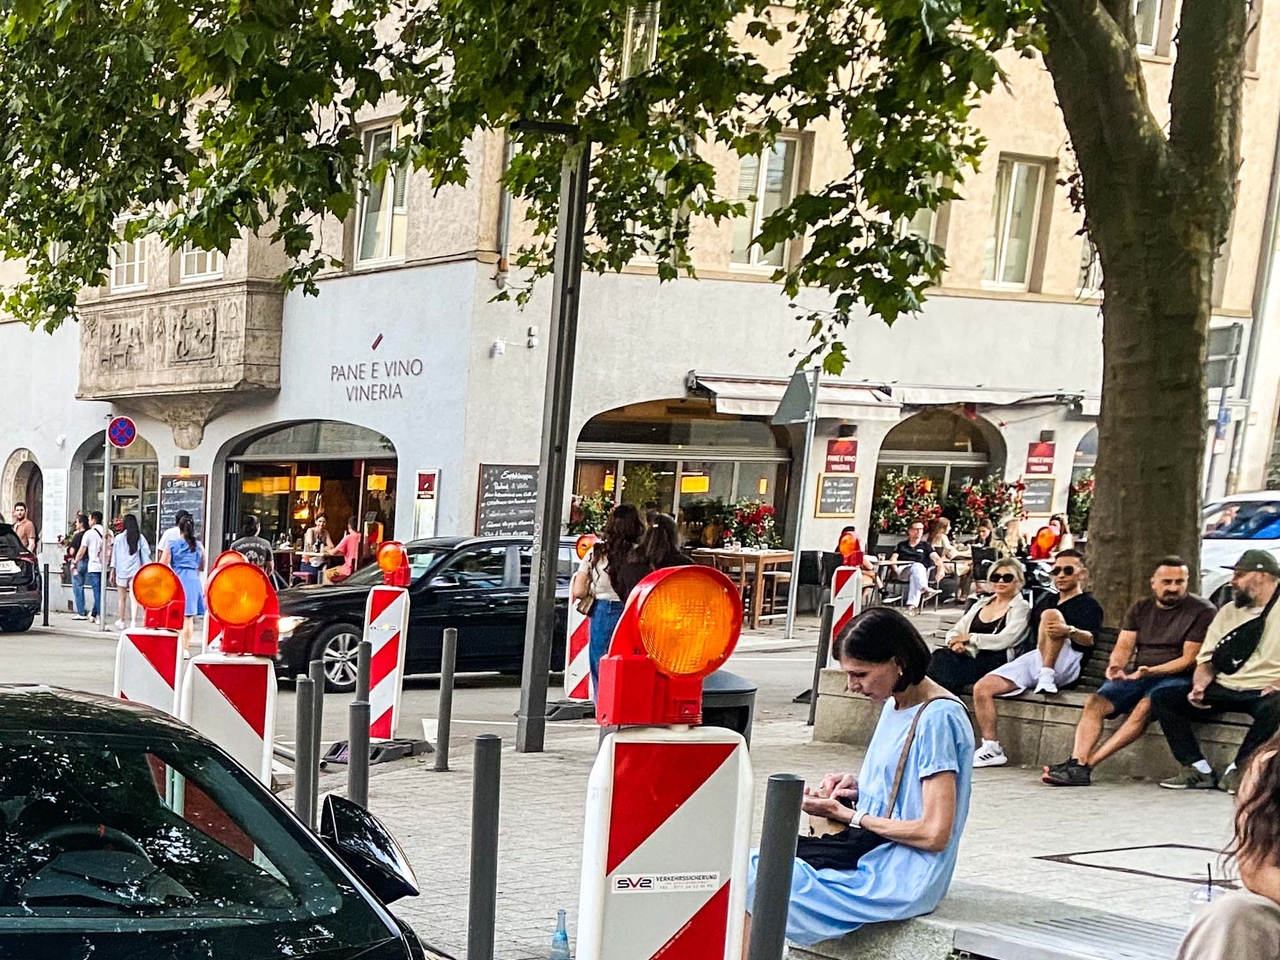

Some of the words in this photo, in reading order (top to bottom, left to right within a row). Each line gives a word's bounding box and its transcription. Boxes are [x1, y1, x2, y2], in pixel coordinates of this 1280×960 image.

[330, 363, 366, 381] PANE
[371, 362, 379, 379] E
[384, 358, 423, 377] VINO
[346, 383, 403, 402] VINERIA
[656, 874, 718, 882] VERKEHRSSICHERUNG
